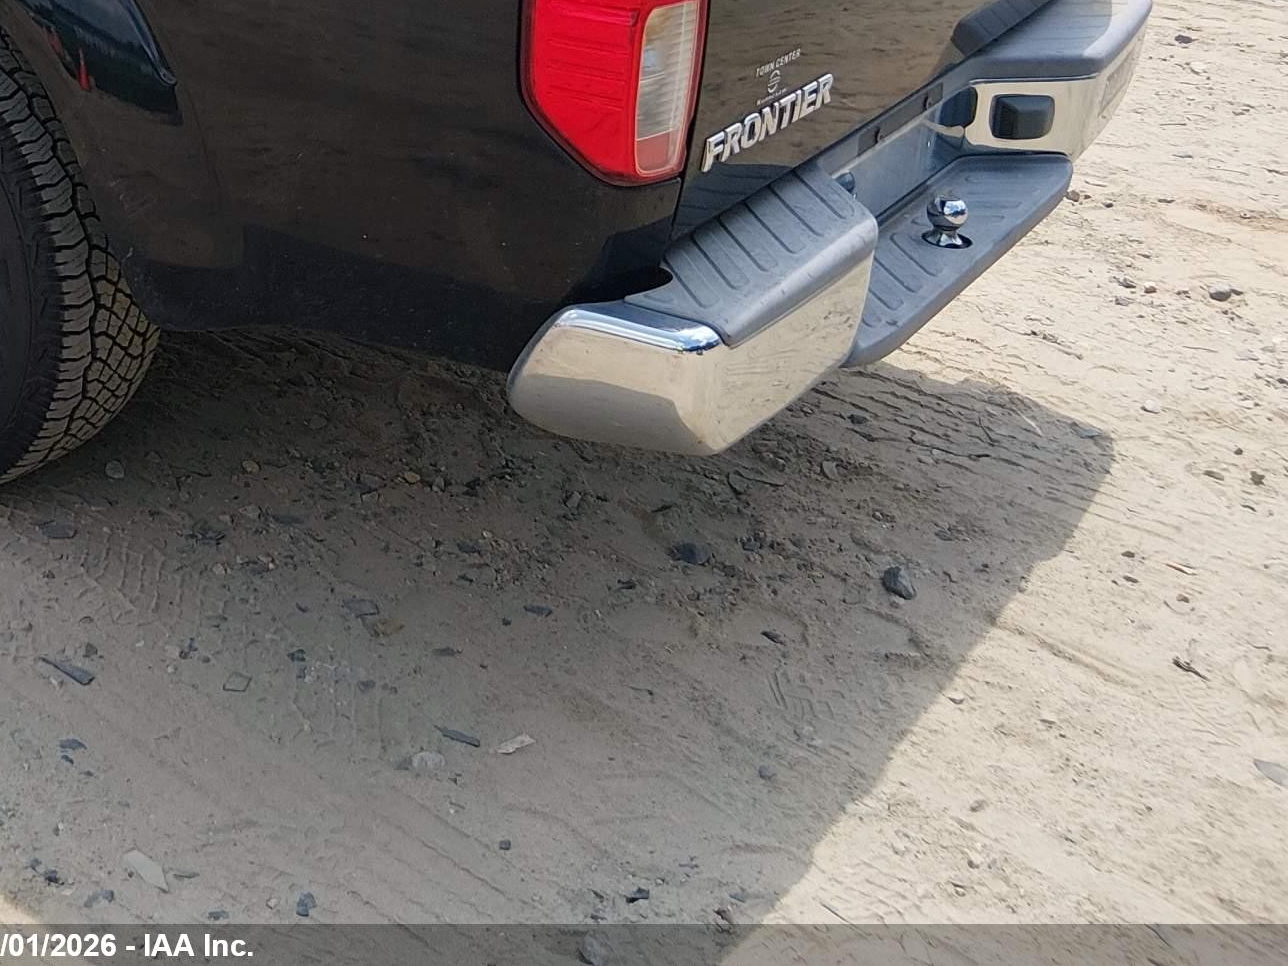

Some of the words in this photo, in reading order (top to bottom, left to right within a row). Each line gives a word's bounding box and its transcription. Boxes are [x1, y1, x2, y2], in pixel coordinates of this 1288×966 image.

[755, 60, 775, 77] TOWN
[775, 48, 801, 68] CENTER
[701, 73, 833, 172] FRONTIER
